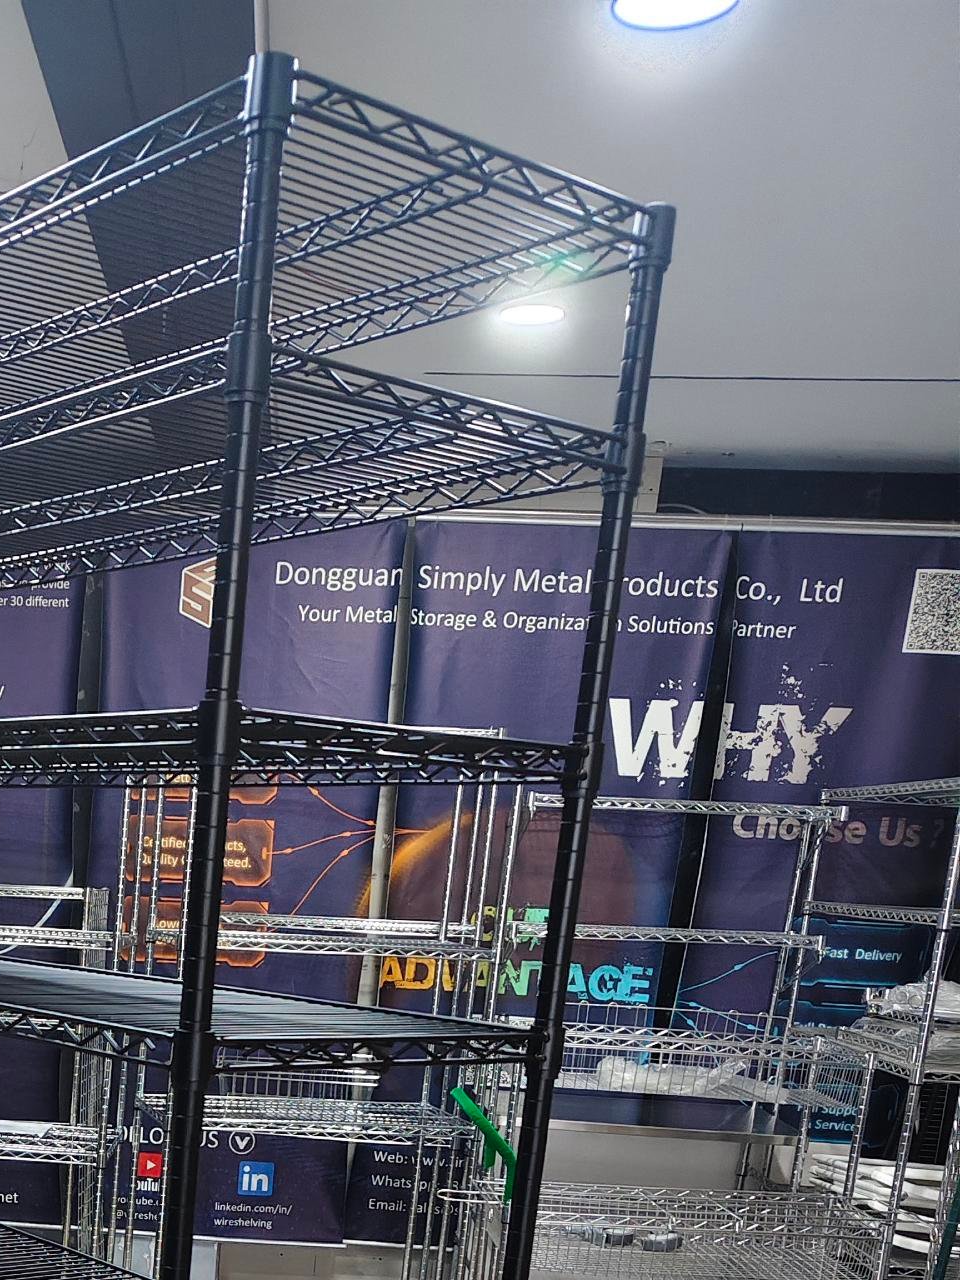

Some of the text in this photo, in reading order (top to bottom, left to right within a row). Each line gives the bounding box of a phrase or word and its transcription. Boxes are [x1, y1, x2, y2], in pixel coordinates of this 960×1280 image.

[275, 561, 844, 605] Dongguan Simply Metal oducts Co., Ltd
[10, 595, 24, 607] 30
[25, 595, 70, 608] different
[298, 604, 341, 623] Your
[345, 605, 398, 624] Metal
[410, 608, 477, 631] Storage
[482, 610, 497, 629] &
[627, 615, 714, 636] Solutions
[608, 697, 853, 785] WHY
[733, 812, 868, 845] Chose
[878, 816, 922, 848] Us
[142, 853, 178, 867] Qulity
[822, 946, 903, 963] Fast Delivery
[380, 954, 654, 1003] ADVANAGE
[374, 1150, 408, 1165] Web:
[214, 1202, 292, 1217] linkedin.com/in/
[368, 1198, 407, 1212] Email:
[214, 1217, 273, 1230] wireshelving
